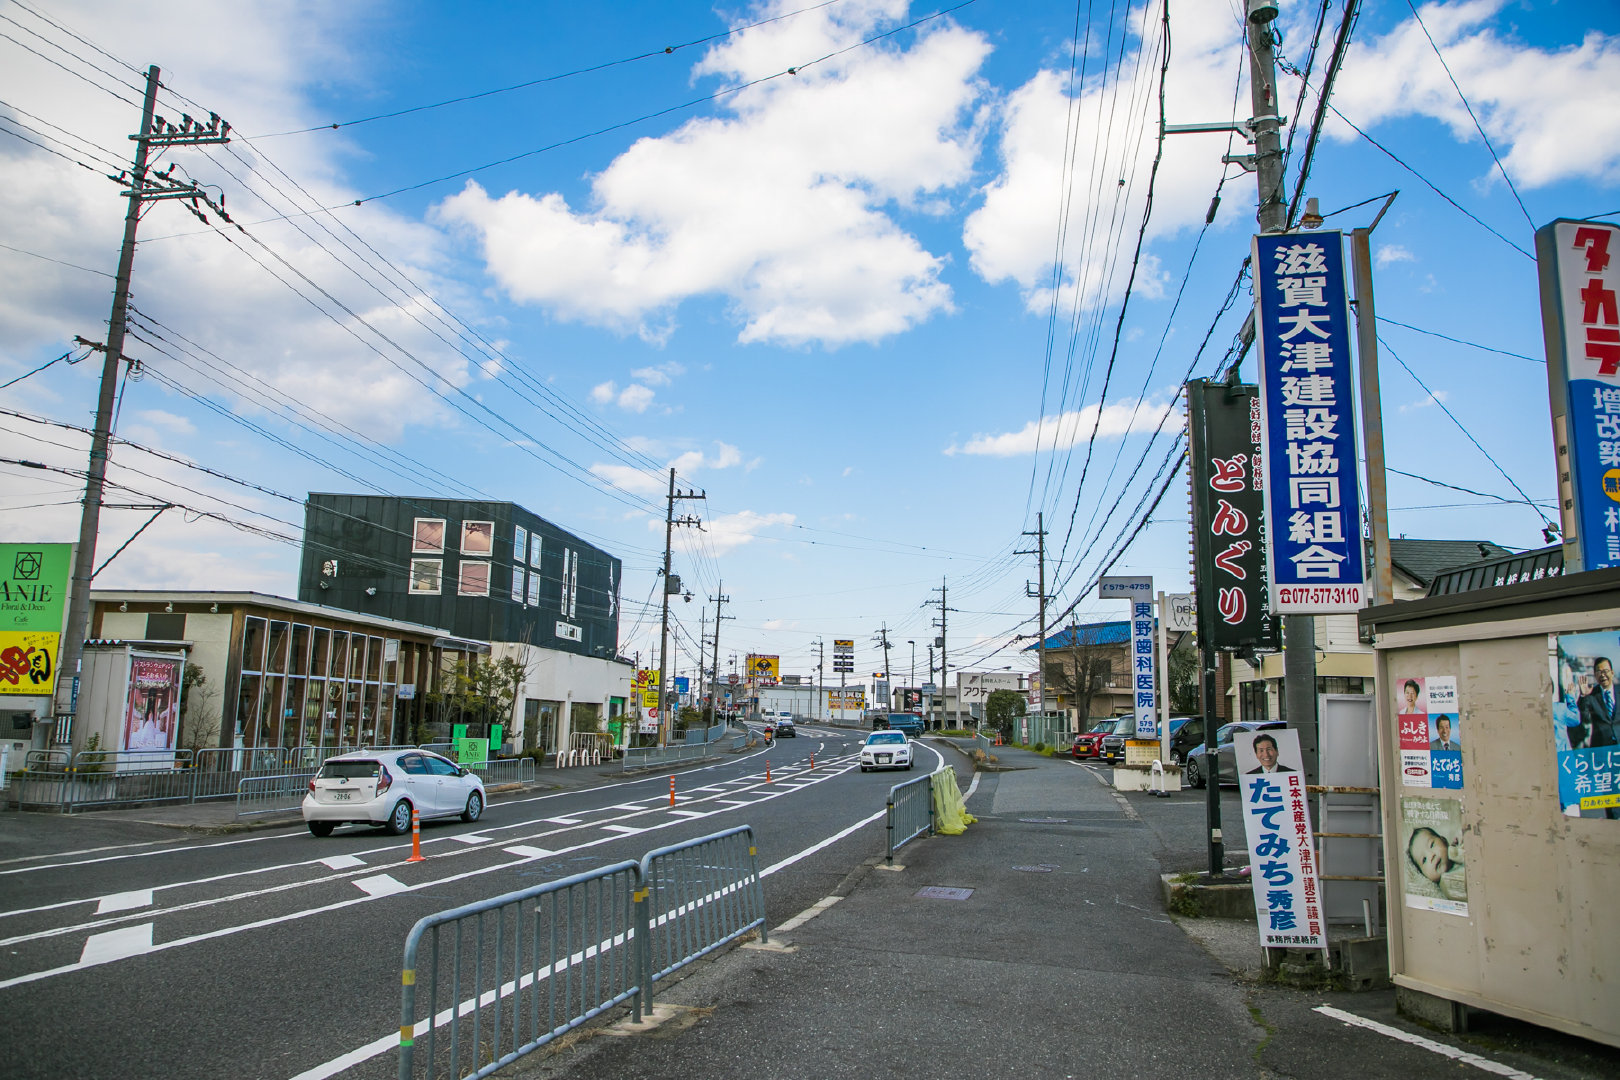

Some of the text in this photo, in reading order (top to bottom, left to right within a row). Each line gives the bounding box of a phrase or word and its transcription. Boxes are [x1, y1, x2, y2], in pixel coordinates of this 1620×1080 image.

[1274, 243, 1347, 579] 滋賀大津建設協同組合
[1210, 453, 1252, 625] どんぐり
[1292, 587, 1359, 605] 077-577-3110
[1134, 602, 1154, 708] 東野歯科医院
[1432, 757, 1461, 773] たてみち
[1249, 777, 1298, 932] たてみち秀彦
[1288, 775, 1322, 937] 日本共産党大津市議会議員
[1266, 935, 1319, 944] 事務所連絡所
